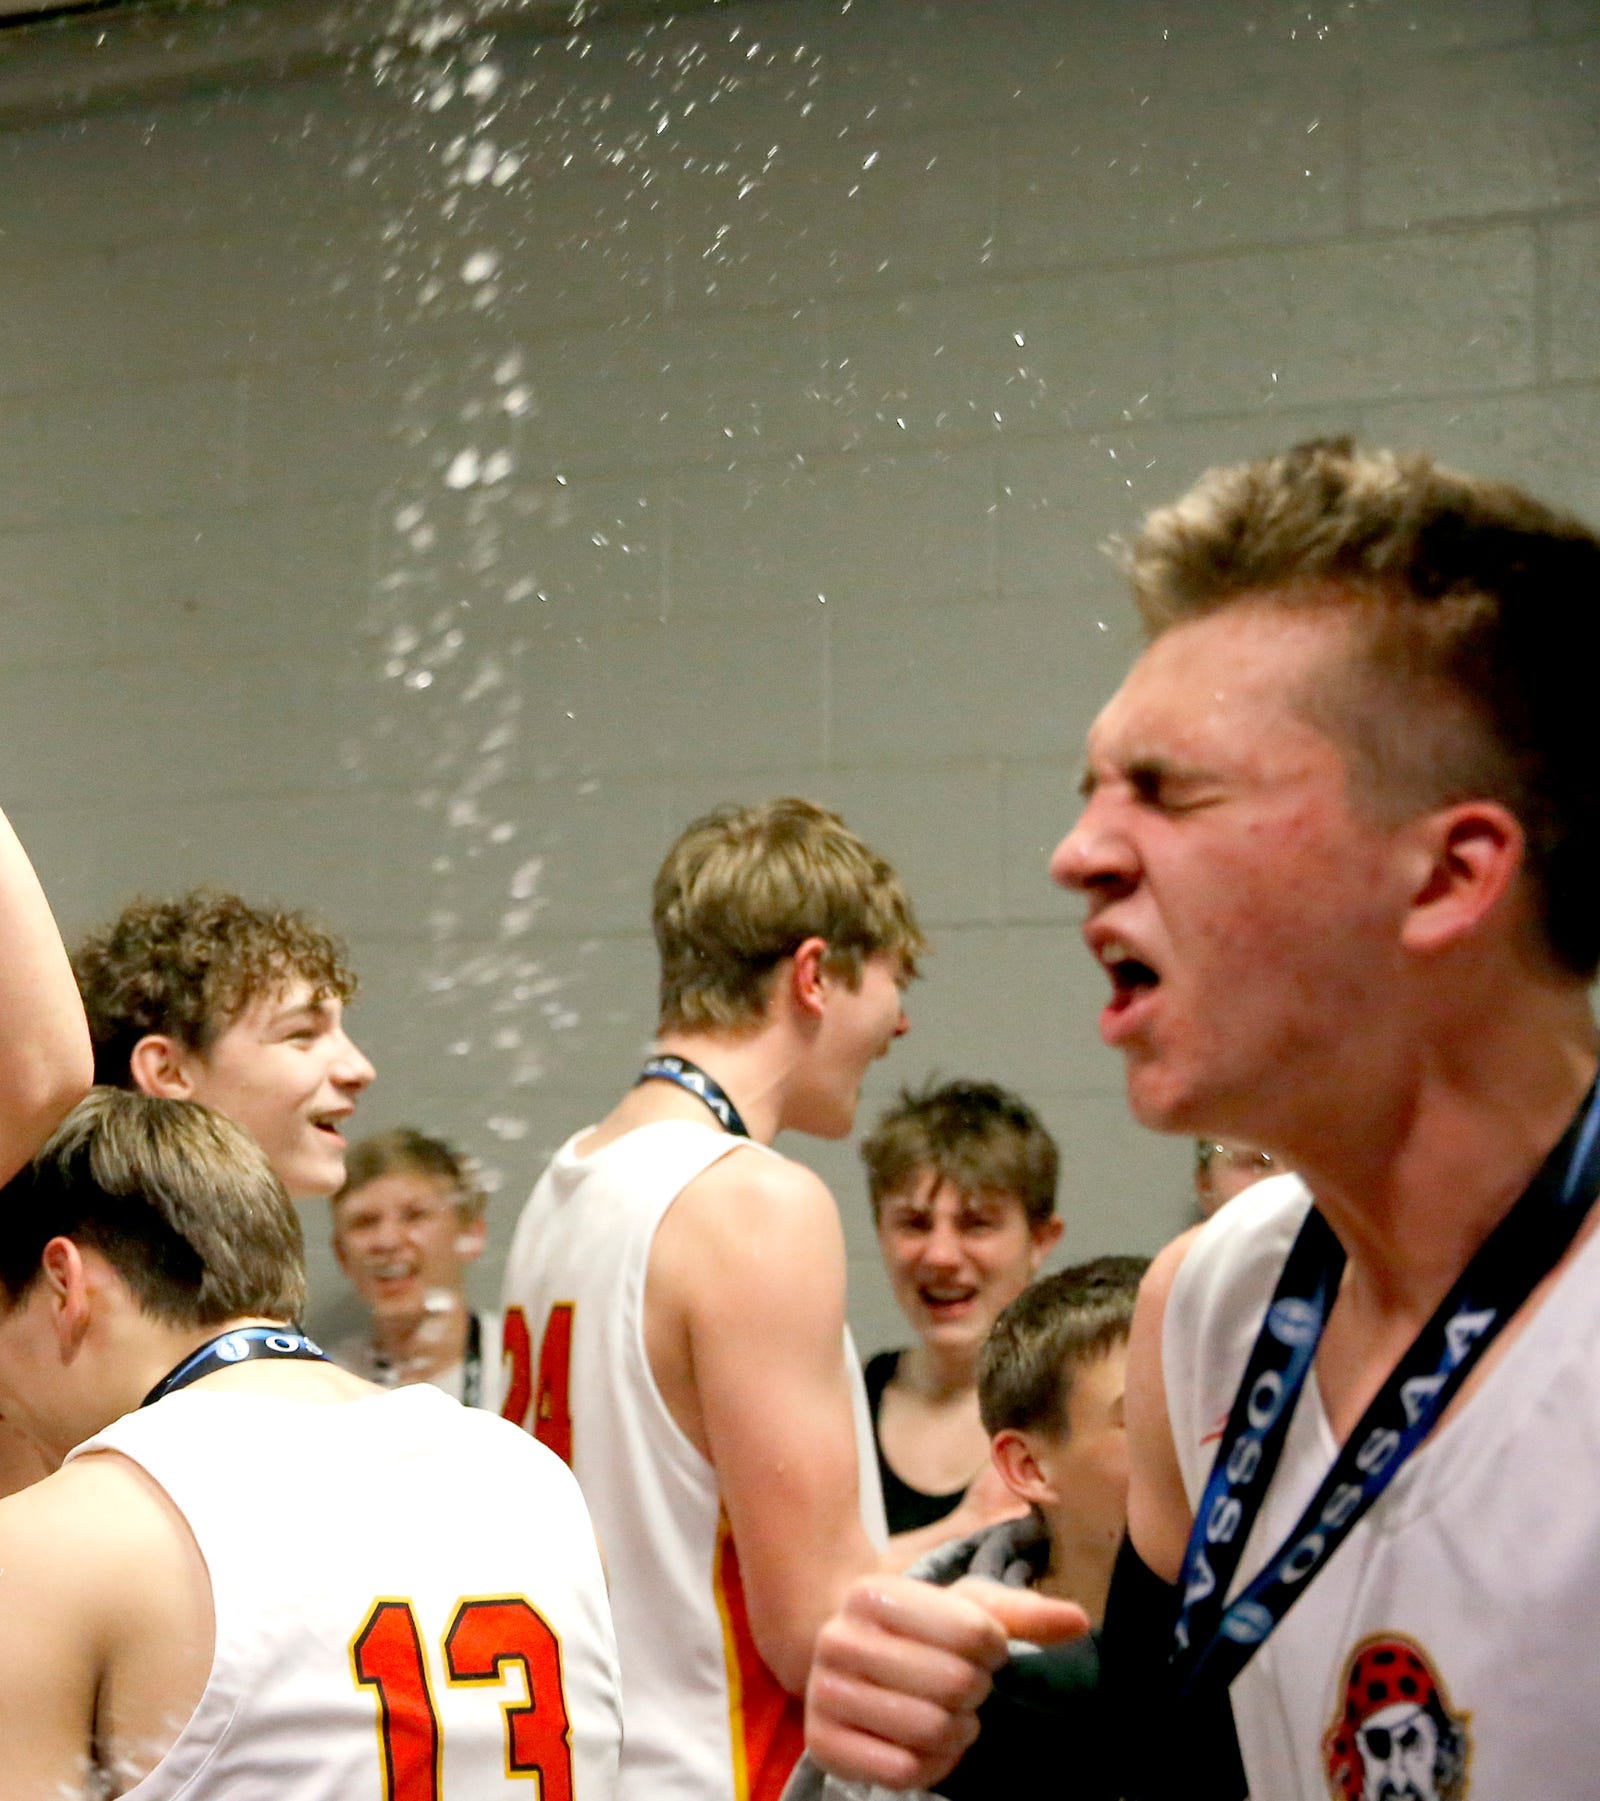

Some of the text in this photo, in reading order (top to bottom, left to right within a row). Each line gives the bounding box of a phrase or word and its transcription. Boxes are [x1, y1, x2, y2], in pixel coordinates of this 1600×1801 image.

[501, 1301, 576, 1470] 24
[1281, 1307, 1497, 1583] OSSAA
[349, 1593, 575, 1801] 13
